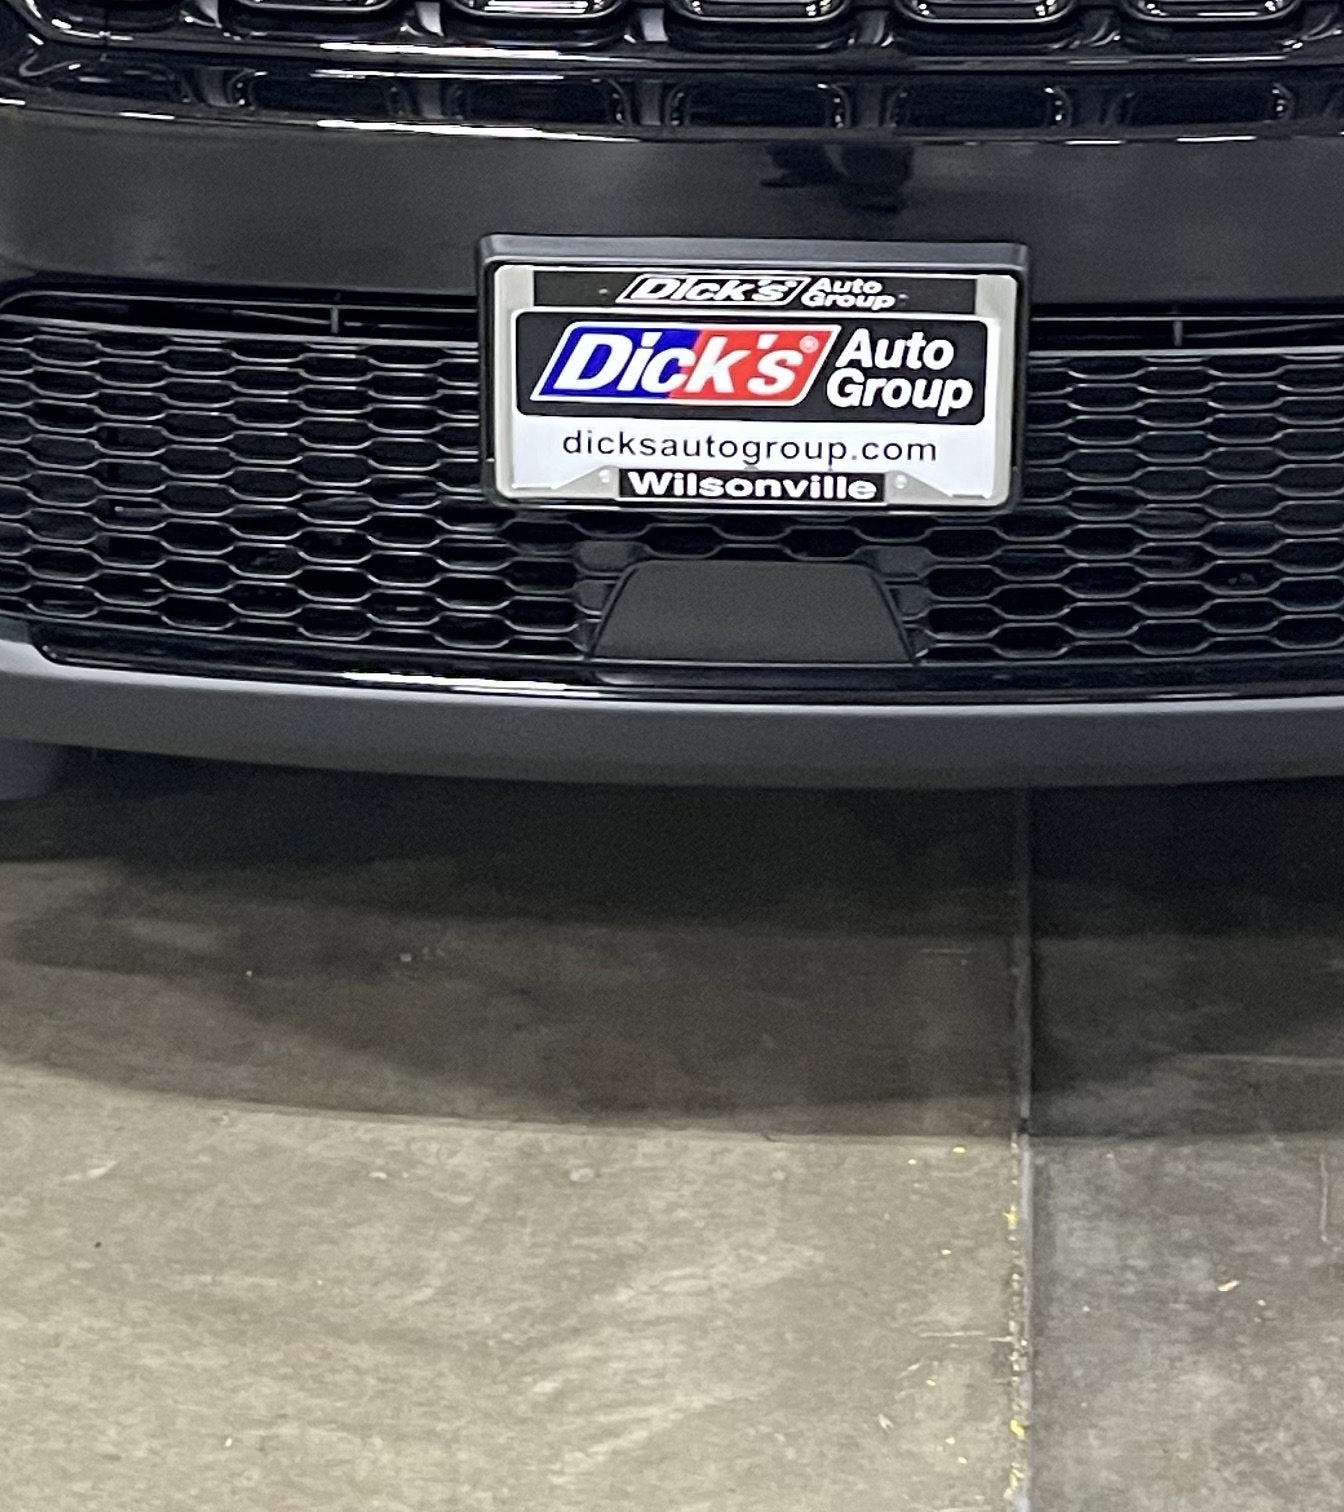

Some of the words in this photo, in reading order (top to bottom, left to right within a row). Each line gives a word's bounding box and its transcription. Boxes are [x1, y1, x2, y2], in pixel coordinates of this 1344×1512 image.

[630, 277, 791, 301] Dick's
[808, 277, 883, 294] Auto
[801, 291, 896, 310] Group
[553, 332, 805, 396] Dick's
[835, 328, 955, 370] Auto
[826, 367, 974, 417] Group
[562, 430, 937, 466] dicksautogroup.com
[627, 470, 878, 501] Wilsonville
